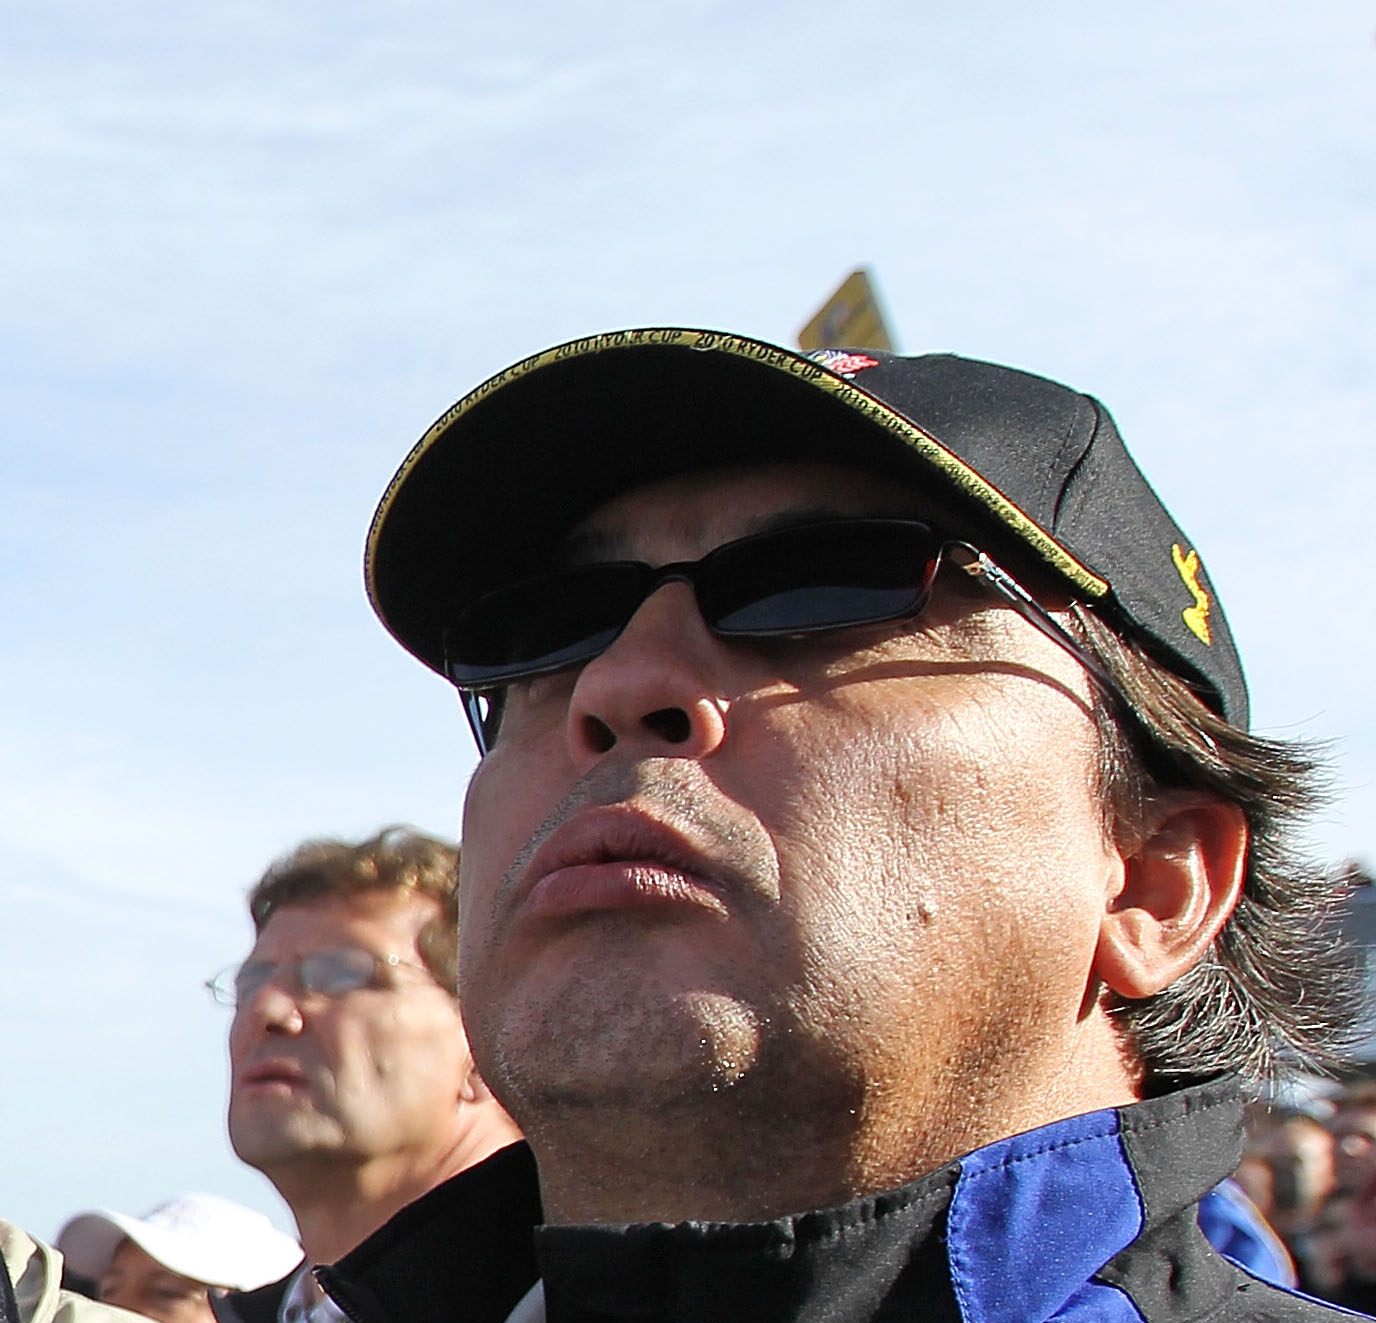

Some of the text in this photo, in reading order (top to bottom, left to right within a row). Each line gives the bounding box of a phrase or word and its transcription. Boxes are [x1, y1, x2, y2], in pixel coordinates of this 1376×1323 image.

[648, 330, 682, 344] CUP
[736, 341, 786, 368] RYDER
[789, 360, 822, 381] CUP
